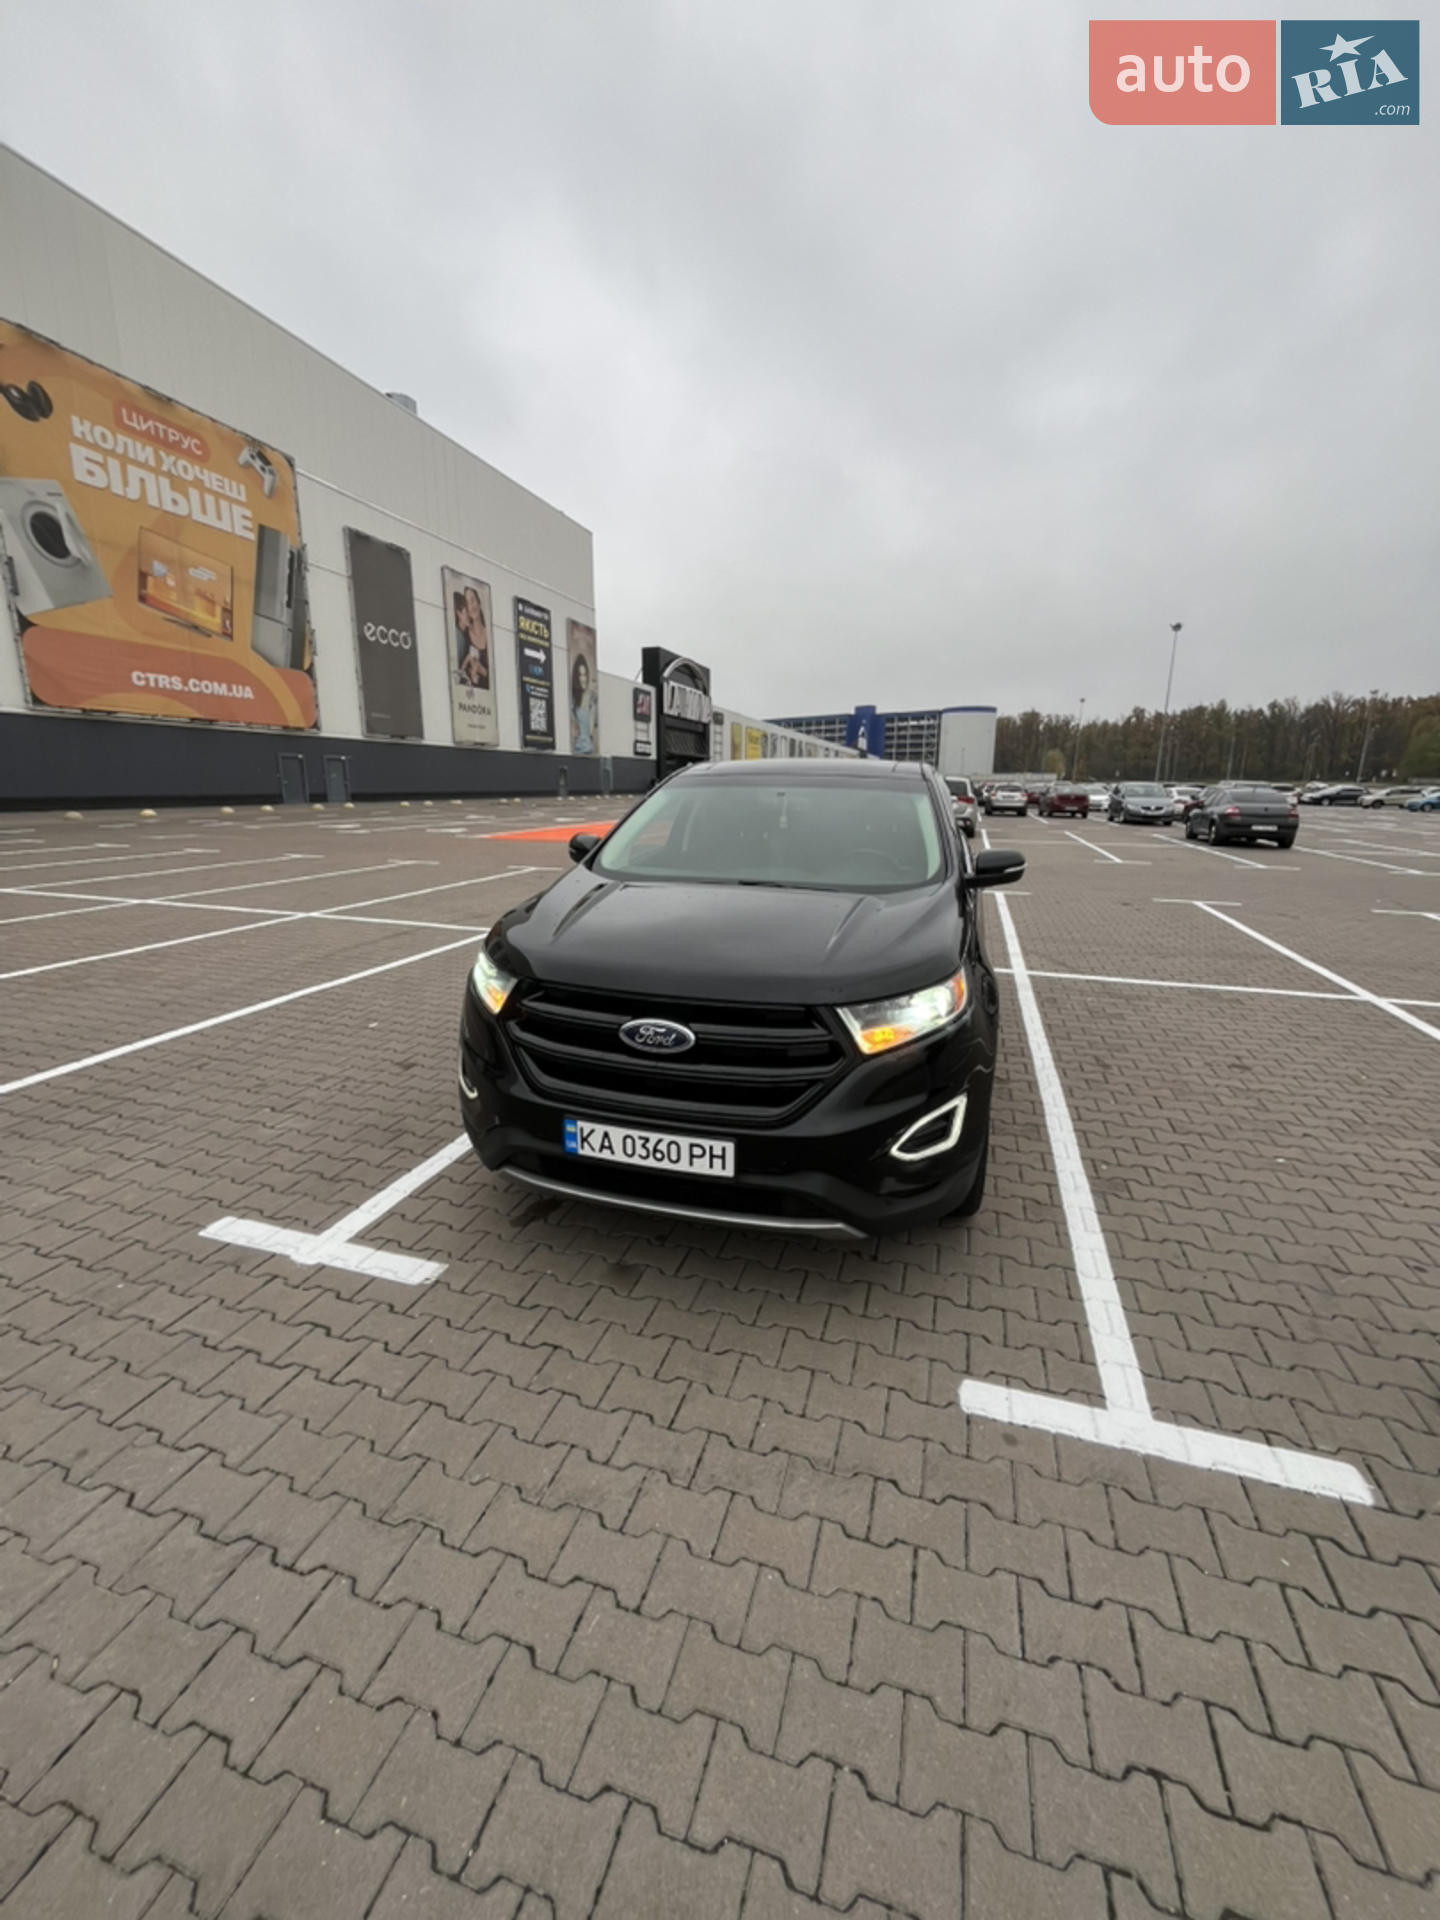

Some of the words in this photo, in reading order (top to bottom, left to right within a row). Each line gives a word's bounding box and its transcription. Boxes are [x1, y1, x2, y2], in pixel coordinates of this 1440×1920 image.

[121, 406, 204, 457] ЦИТРУС
[70, 414, 156, 465] КОЛИ
[159, 449, 248, 503] ХОЧЕШ
[69, 443, 256, 541] БІЛЬШЕ
[363, 621, 412, 650] ecco
[131, 670, 255, 701] CTRS.COM.UA
[458, 701, 492, 716] PANDORA
[634, 1025, 677, 1047] Ford
[578, 1126, 615, 1155] KA
[621, 1133, 681, 1165] 0360
[688, 1142, 727, 1171] PH
